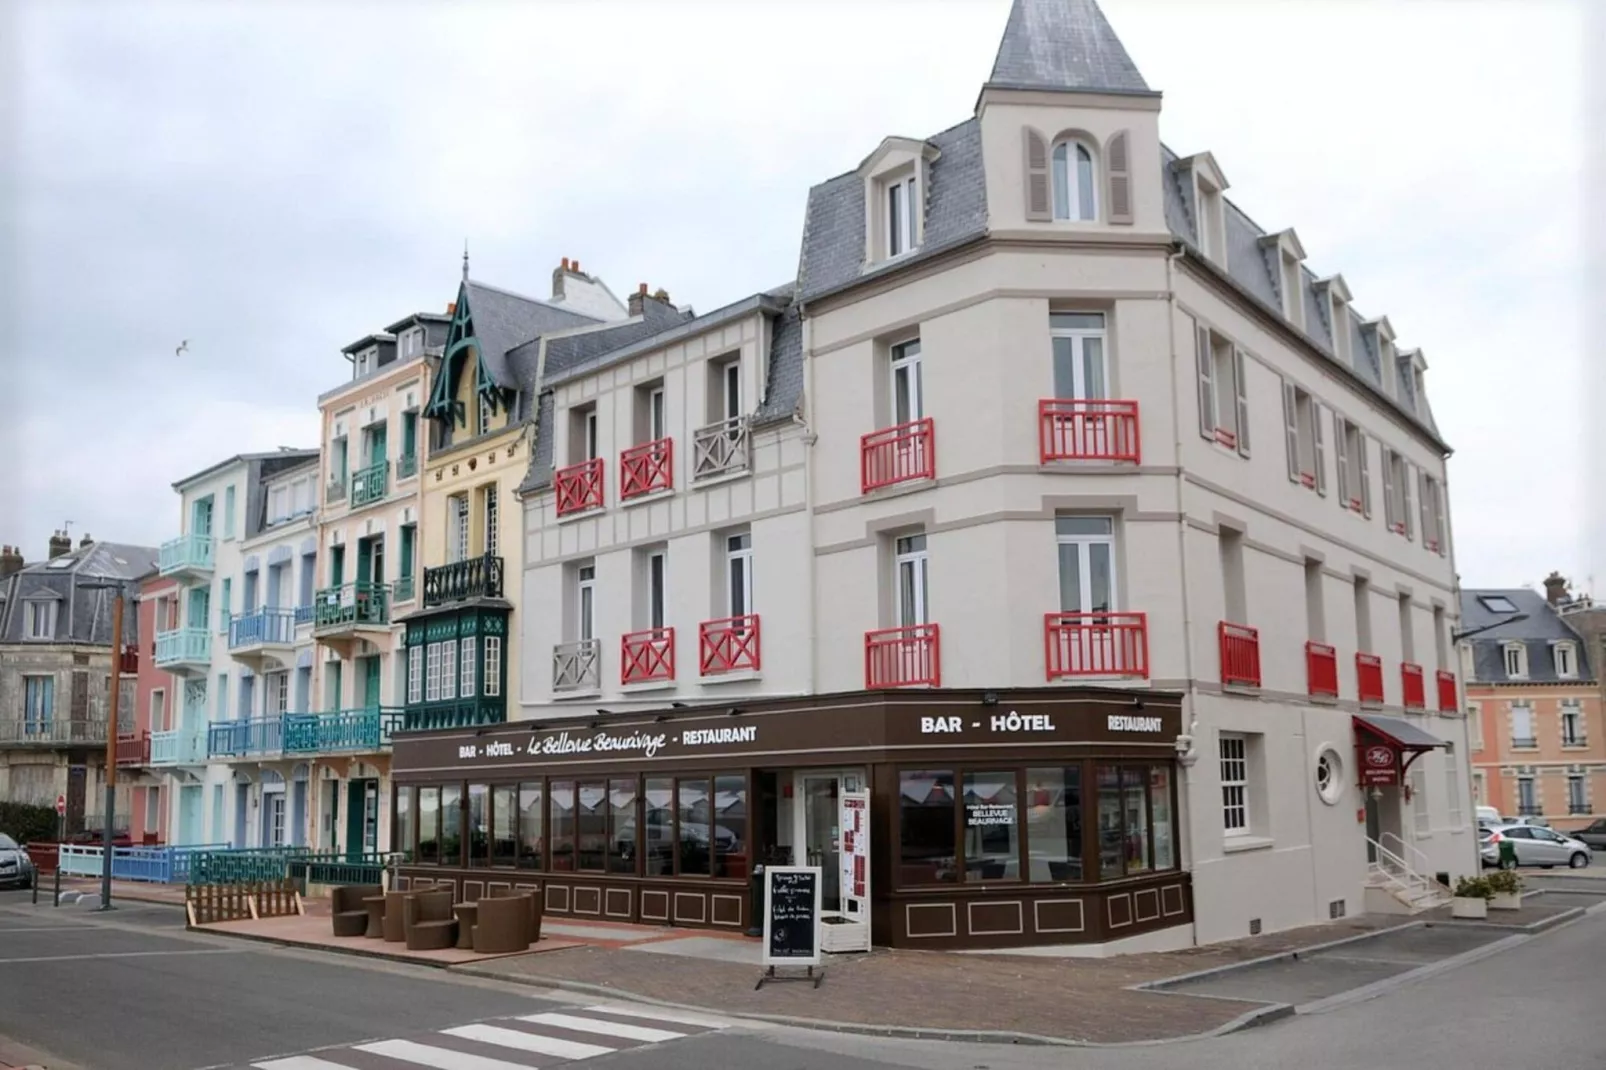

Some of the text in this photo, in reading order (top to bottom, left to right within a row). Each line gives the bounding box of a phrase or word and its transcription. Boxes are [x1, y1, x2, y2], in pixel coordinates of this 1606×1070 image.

[920, 716, 962, 733] BAR
[990, 710, 1056, 732] HÔTEL
[1107, 714, 1162, 732] RESTAURANT
[459, 745, 477, 759] BAR
[486, 740, 515, 757] HÔTEL
[526, 735, 541, 755] Le
[542, 731, 592, 755] Bellevue
[593, 730, 667, 758] Beaurivage
[682, 726, 757, 745] RESTAURANT
